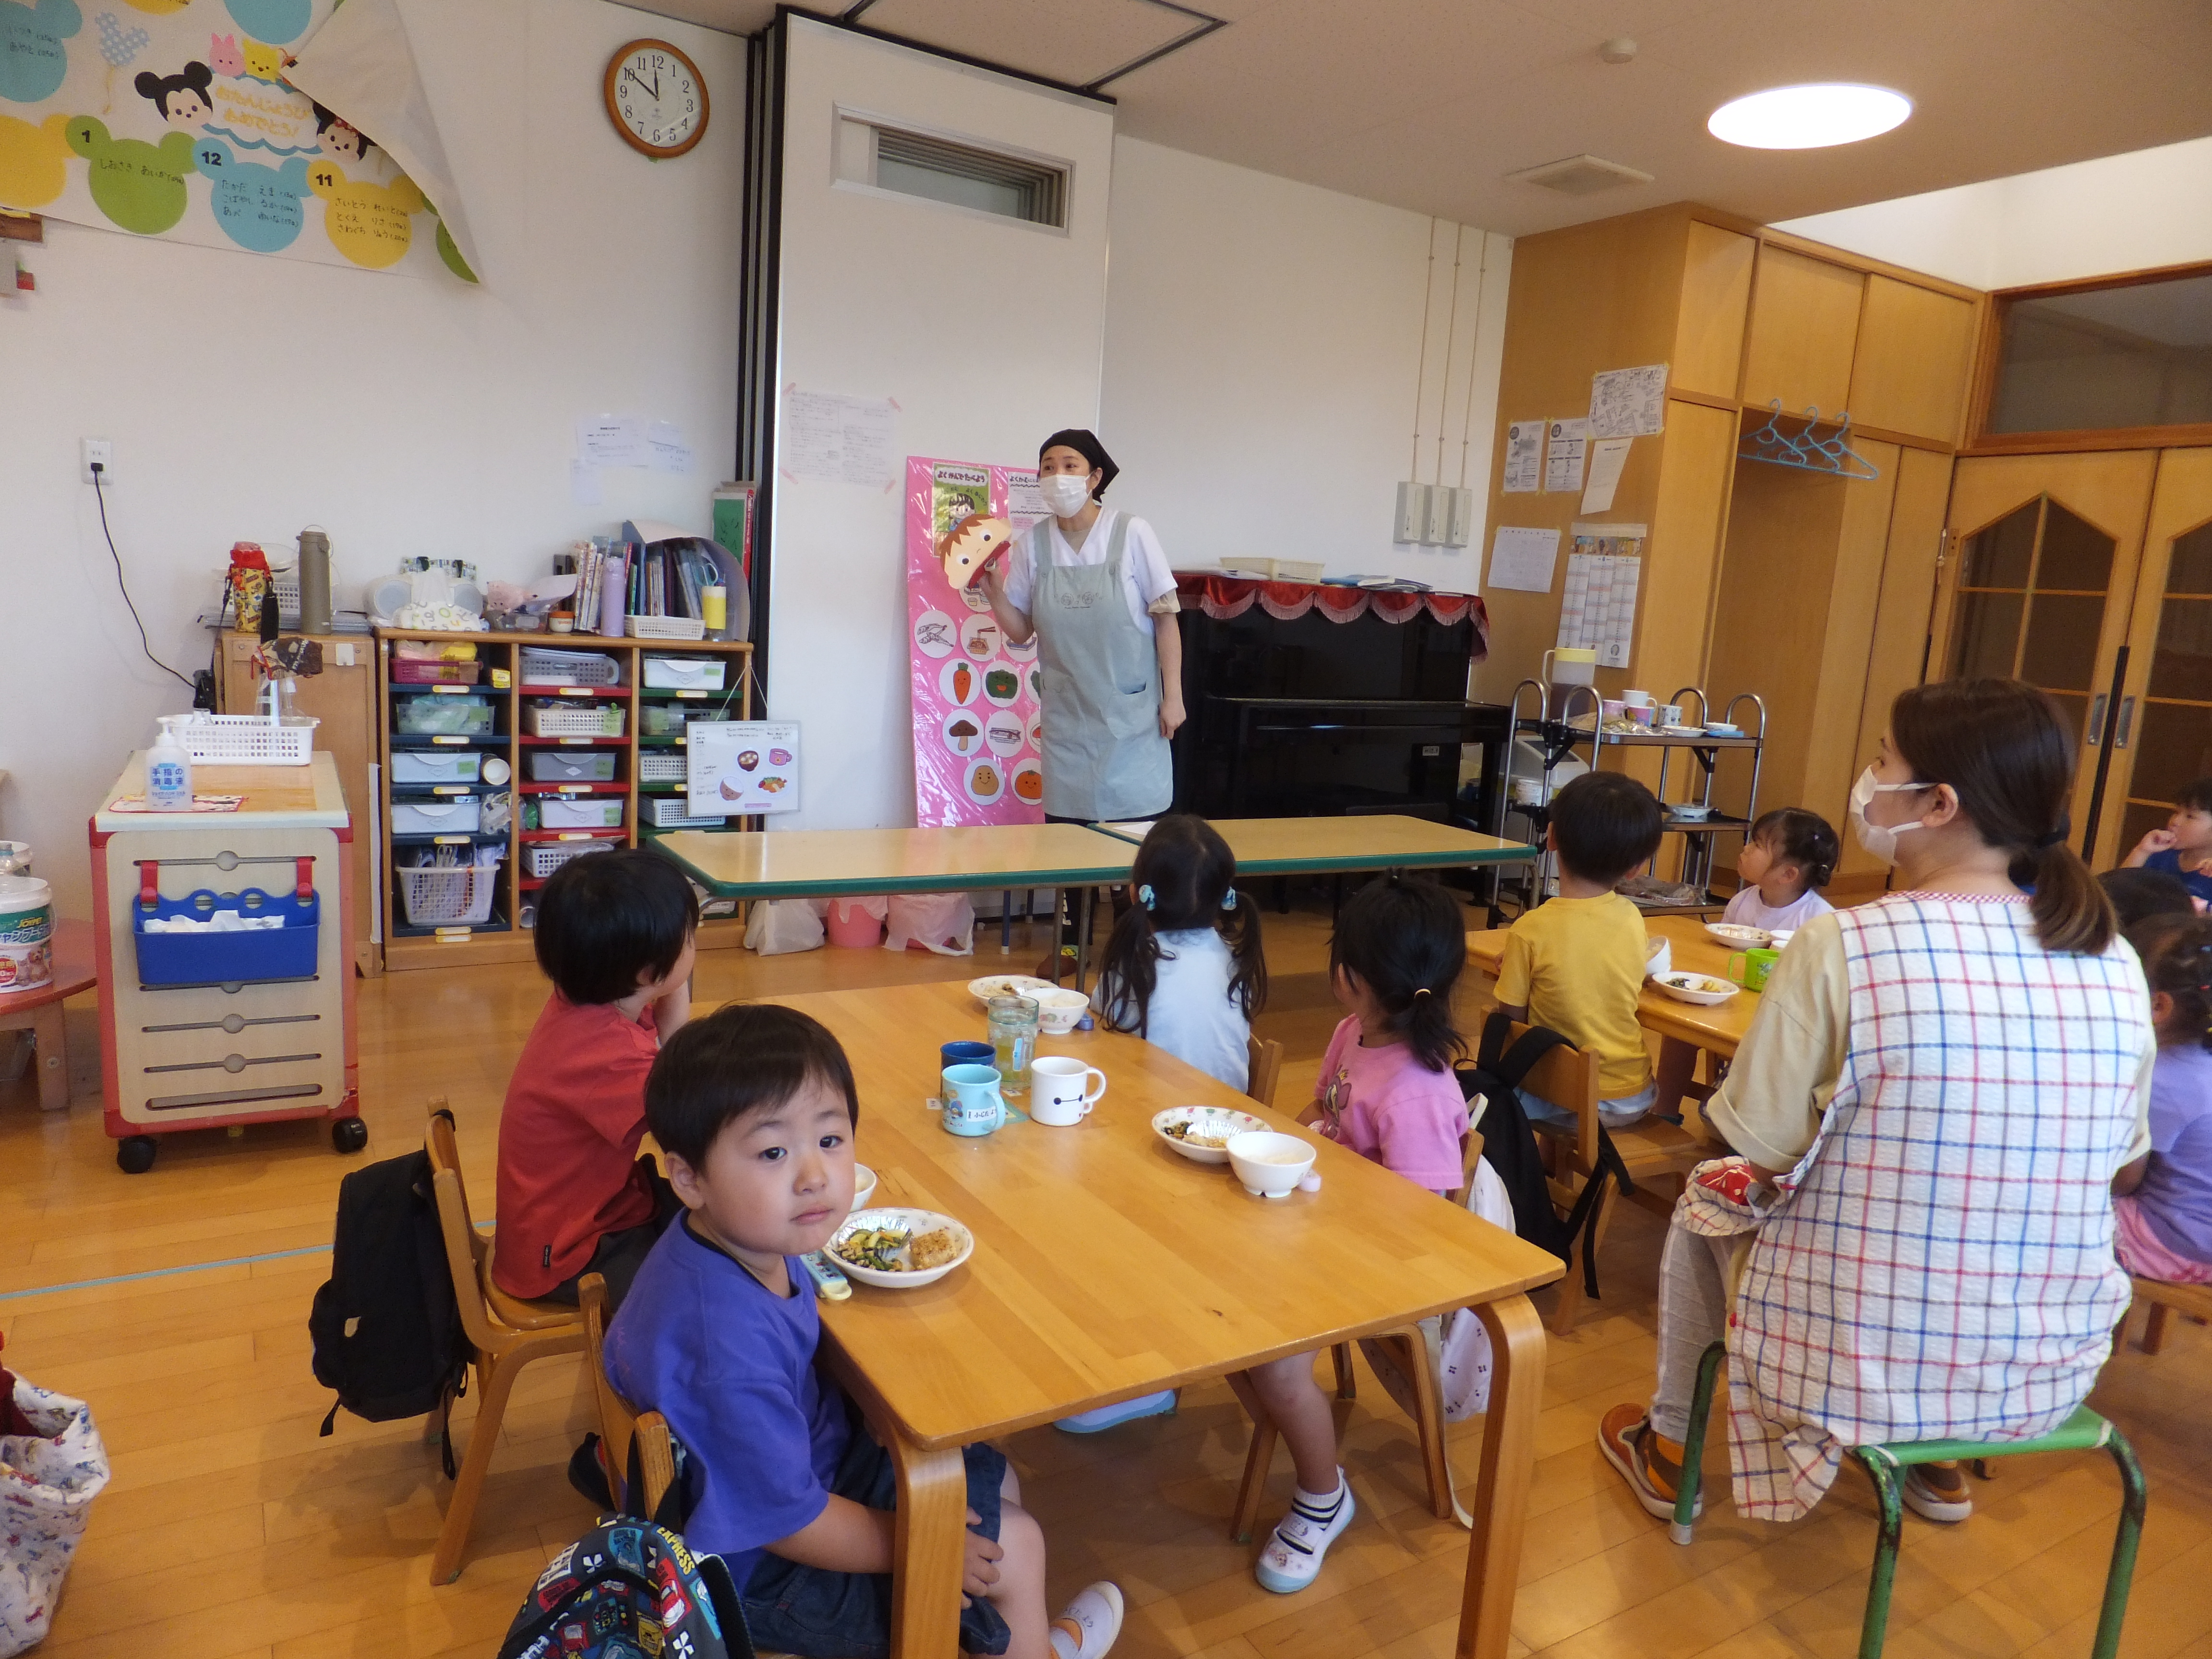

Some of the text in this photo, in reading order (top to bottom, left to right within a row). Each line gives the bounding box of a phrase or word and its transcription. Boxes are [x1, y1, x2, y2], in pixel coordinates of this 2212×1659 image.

[637, 57, 646, 71] 11
[652, 55, 664, 70] 12
[624, 67, 635, 81] 10
[672, 64, 676, 77] 1
[620, 85, 627, 98] 9
[682, 80, 689, 94] 2
[625, 105, 633, 119] 8
[686, 98, 693, 113] 3
[637, 121, 644, 134] 7
[681, 117, 687, 130] 4
[82, 130, 90, 143] 1
[653, 129, 661, 142] 6
[669, 128, 676, 141] 5
[201, 151, 222, 166] 12
[316, 173, 333, 187] 11
